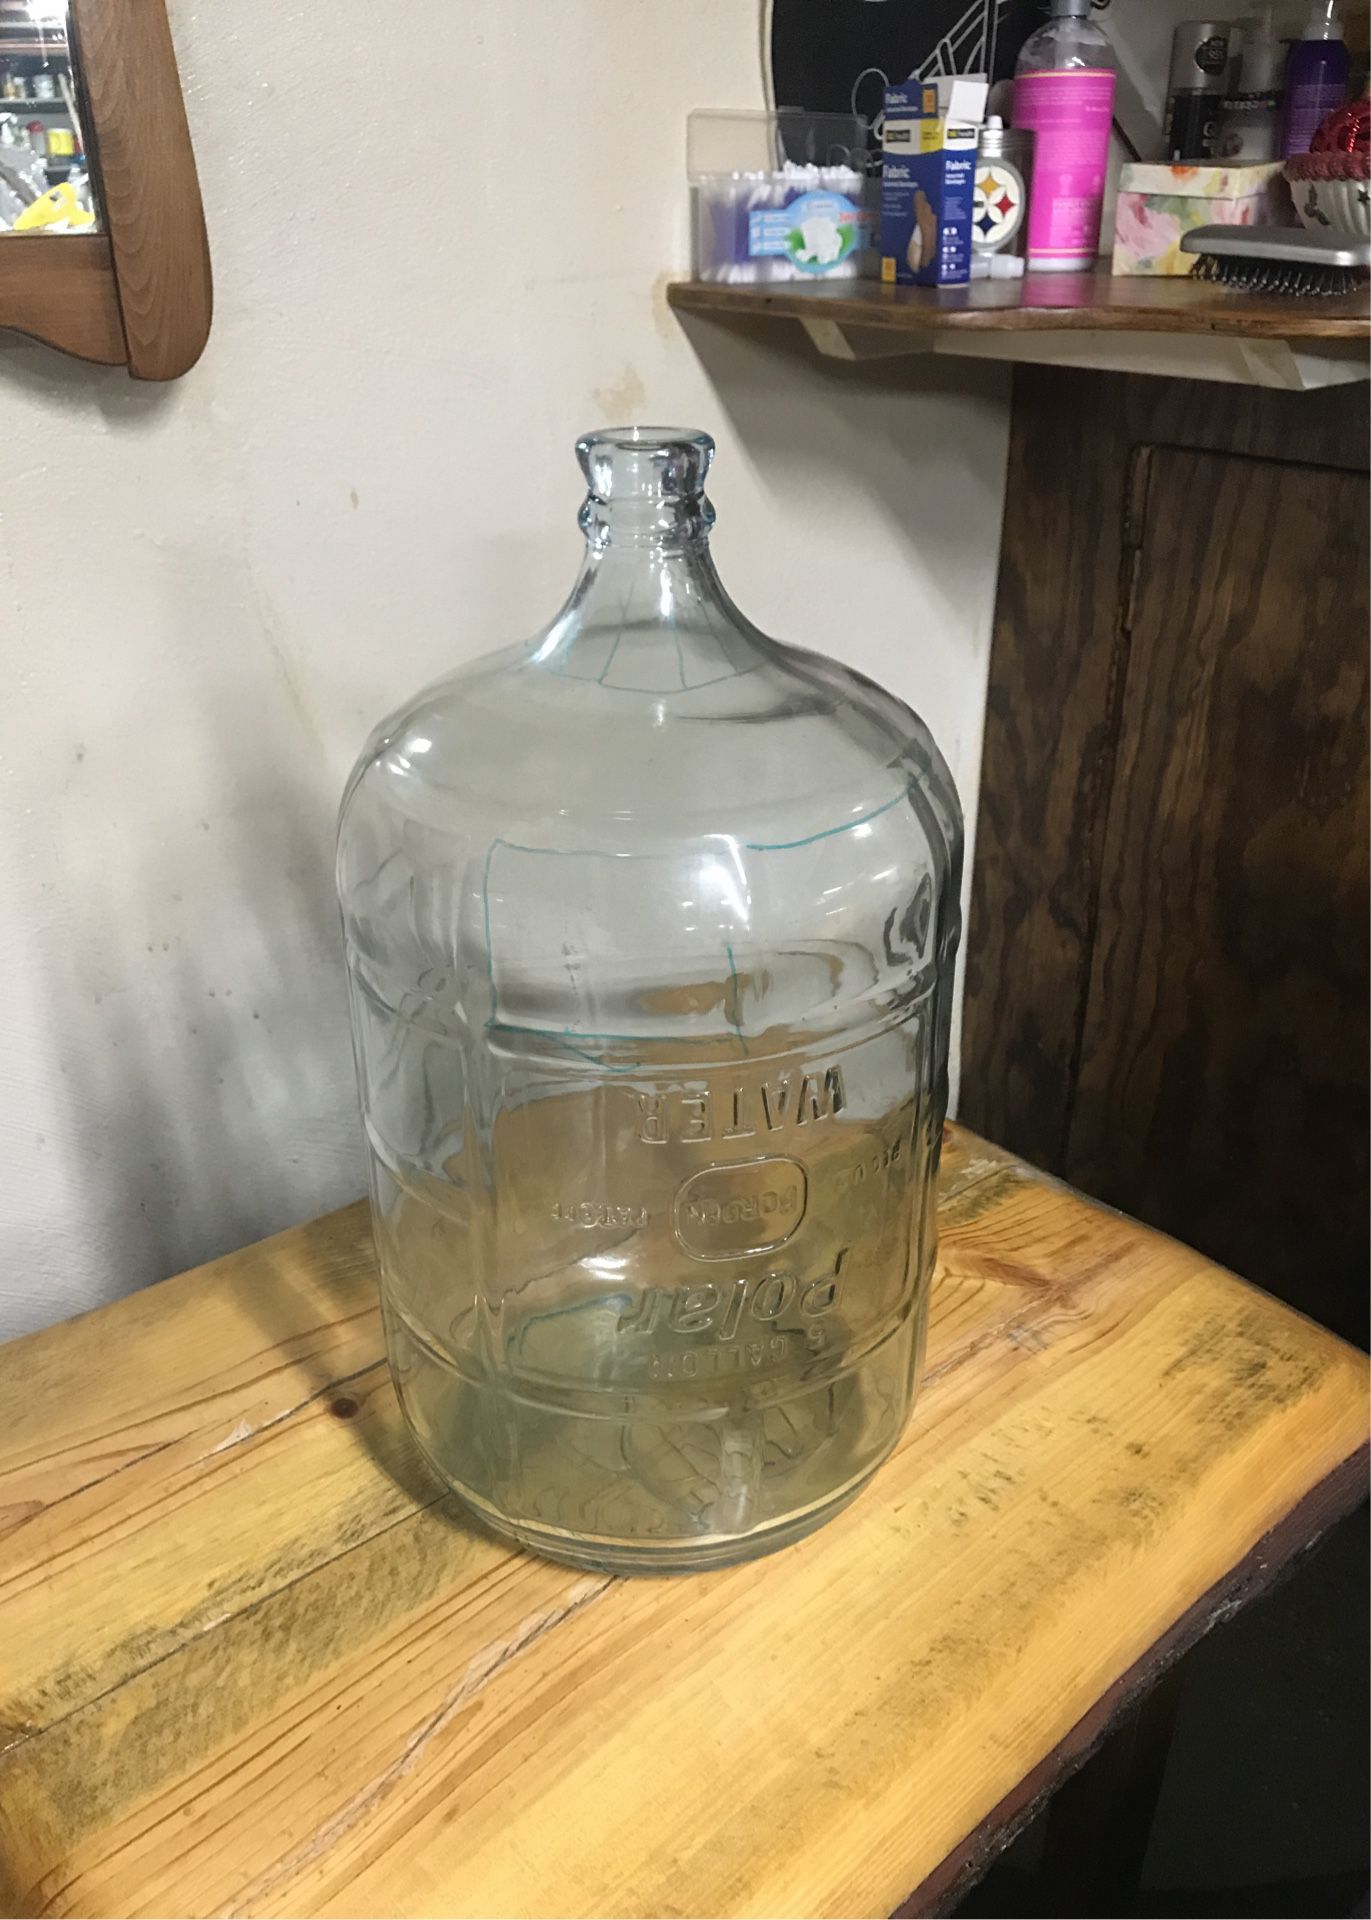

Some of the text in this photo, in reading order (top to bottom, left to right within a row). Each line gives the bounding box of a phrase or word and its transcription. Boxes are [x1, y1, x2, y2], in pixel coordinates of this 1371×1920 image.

[882, 165, 910, 178] Fabric
[945, 159, 972, 171] Fabric
[625, 1064, 847, 1145] WATER
[647, 1334, 787, 1381] GALLON
